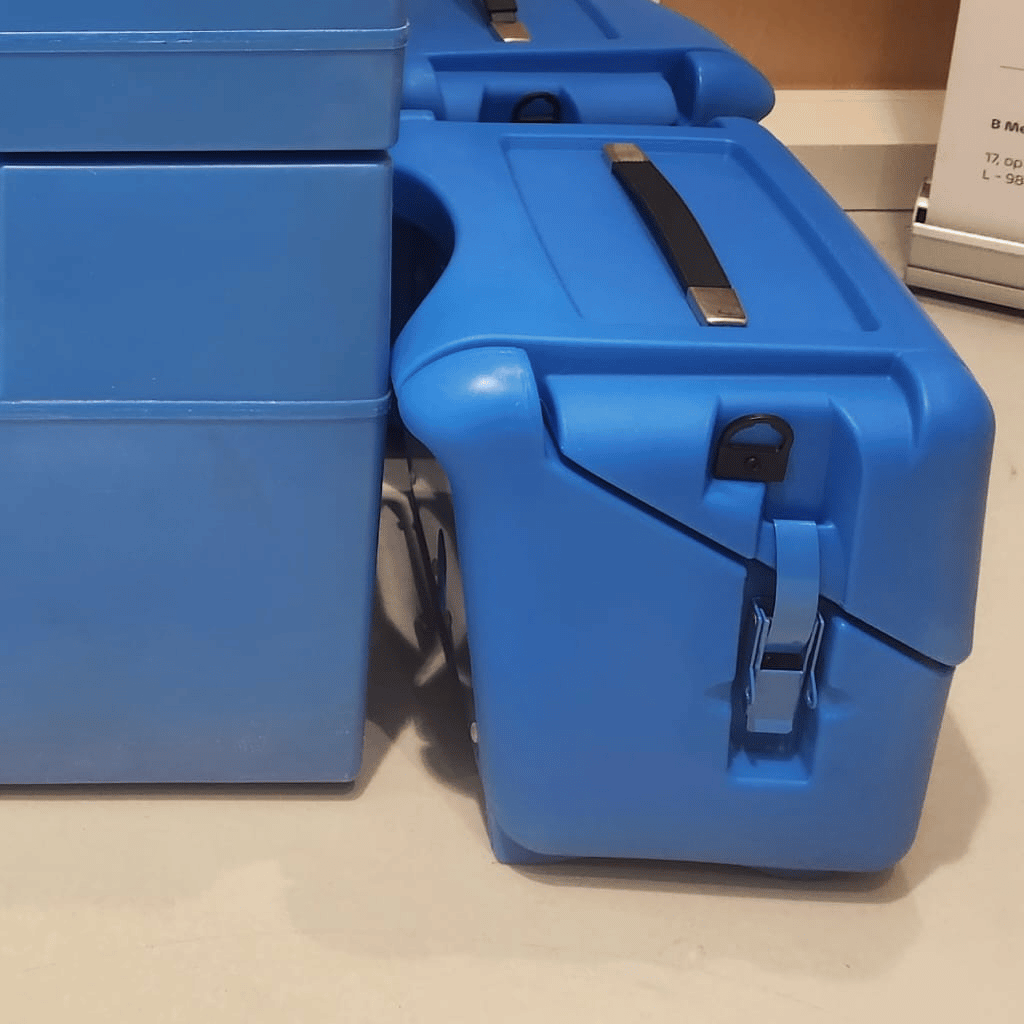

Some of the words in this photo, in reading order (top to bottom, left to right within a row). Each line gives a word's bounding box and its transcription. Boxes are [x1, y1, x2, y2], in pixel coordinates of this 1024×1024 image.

[991, 118, 1001, 129] B
[1004, 157, 1023, 170] op
[982, 169, 990, 180] L
